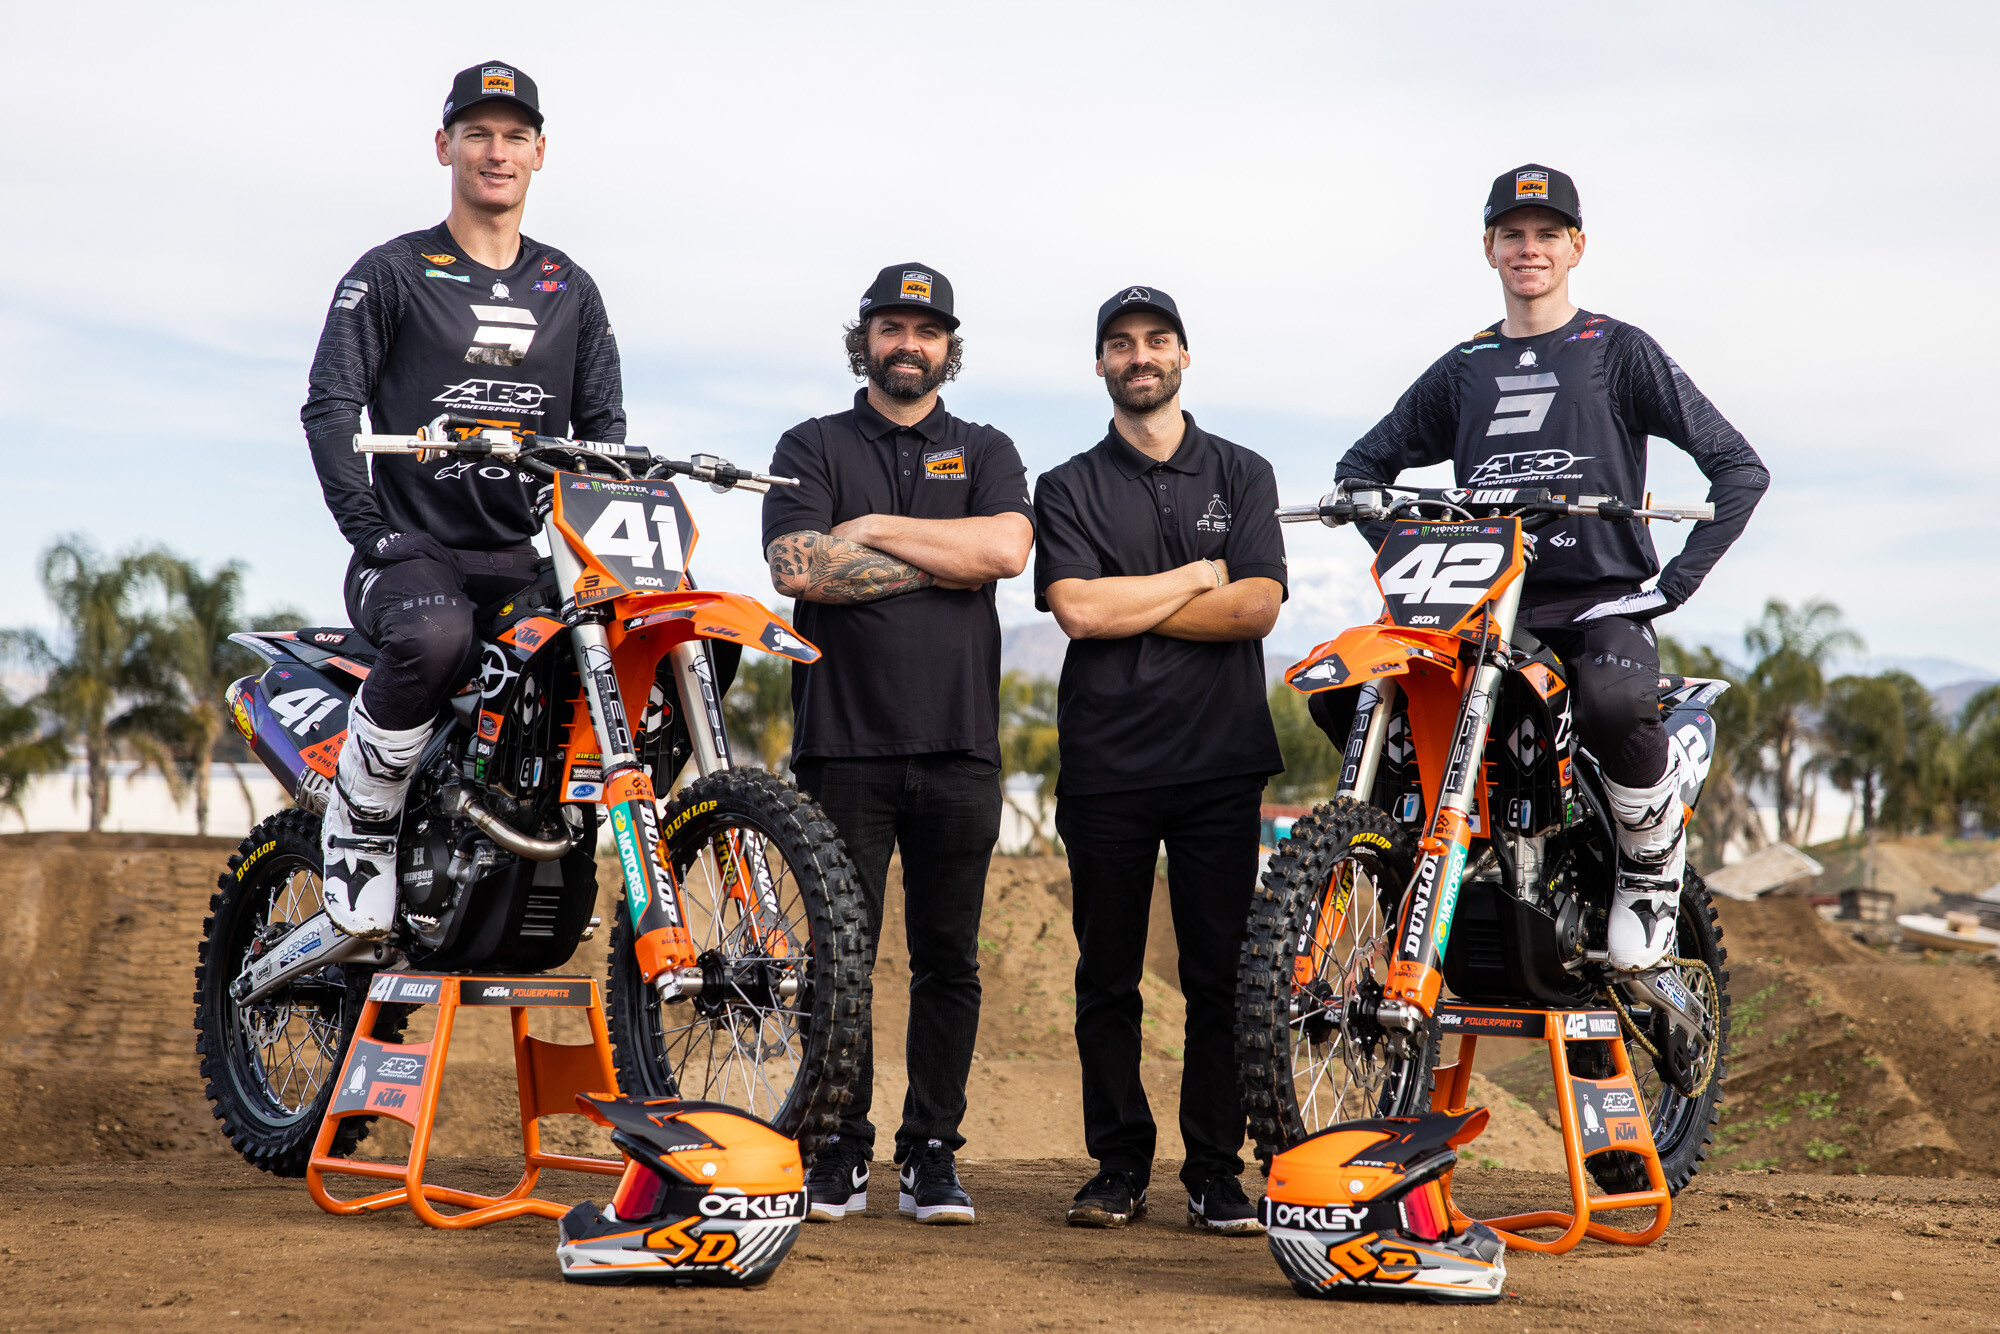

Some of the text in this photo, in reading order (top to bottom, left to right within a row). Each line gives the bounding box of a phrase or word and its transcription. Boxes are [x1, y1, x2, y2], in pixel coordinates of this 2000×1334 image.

[487, 79, 510, 87] KTM
[1521, 183, 1543, 191] KTM
[531, 280, 568, 292] AMA
[906, 284, 928, 293] KTM
[431, 378, 556, 409] AEO
[927, 471, 948, 479] RACING
[931, 462, 959, 471] KTM
[1468, 449, 1596, 483] AEO
[570, 481, 670, 497] AMA MONSTER AMA
[1477, 474, 1583, 487] POWERSPORTS.COM
[1471, 488, 1520, 503] odi
[1196, 519, 1232, 529] AE
[1398, 528, 1419, 536] AMA
[1431, 525, 1480, 534] MONSTER
[583, 500, 684, 573] 41
[635, 576, 664, 587] SKDA
[1379, 543, 1505, 605] 42
[580, 588, 608, 598] SHOT
[402, 595, 458, 611] SHOT
[1409, 615, 1441, 625] SKDA
[314, 633, 344, 643] GUTS
[516, 627, 543, 647] KTM
[268, 688, 343, 736] 41
[664, 800, 718, 840] DUNLOP
[1348, 831, 1393, 850] DUNLOP
[235, 840, 277, 882] DUNLOP
[618, 830, 648, 909] MOTOREX
[403, 869, 433, 882] HINSON
[1440, 848, 1466, 923] MOTOREX
[368, 976, 570, 1001] 41 KELLEY KTM POWERPARTS
[1437, 1013, 1616, 1038] KTM POWERPARTS 42 VARIZE
[376, 1056, 424, 1075] AEO
[373, 1088, 407, 1108] KTM
[1602, 1092, 1635, 1109] AEO
[1615, 1122, 1638, 1141] KTM
[698, 1192, 799, 1219] OAKLEY
[1276, 1204, 1369, 1230] OAKLEY
